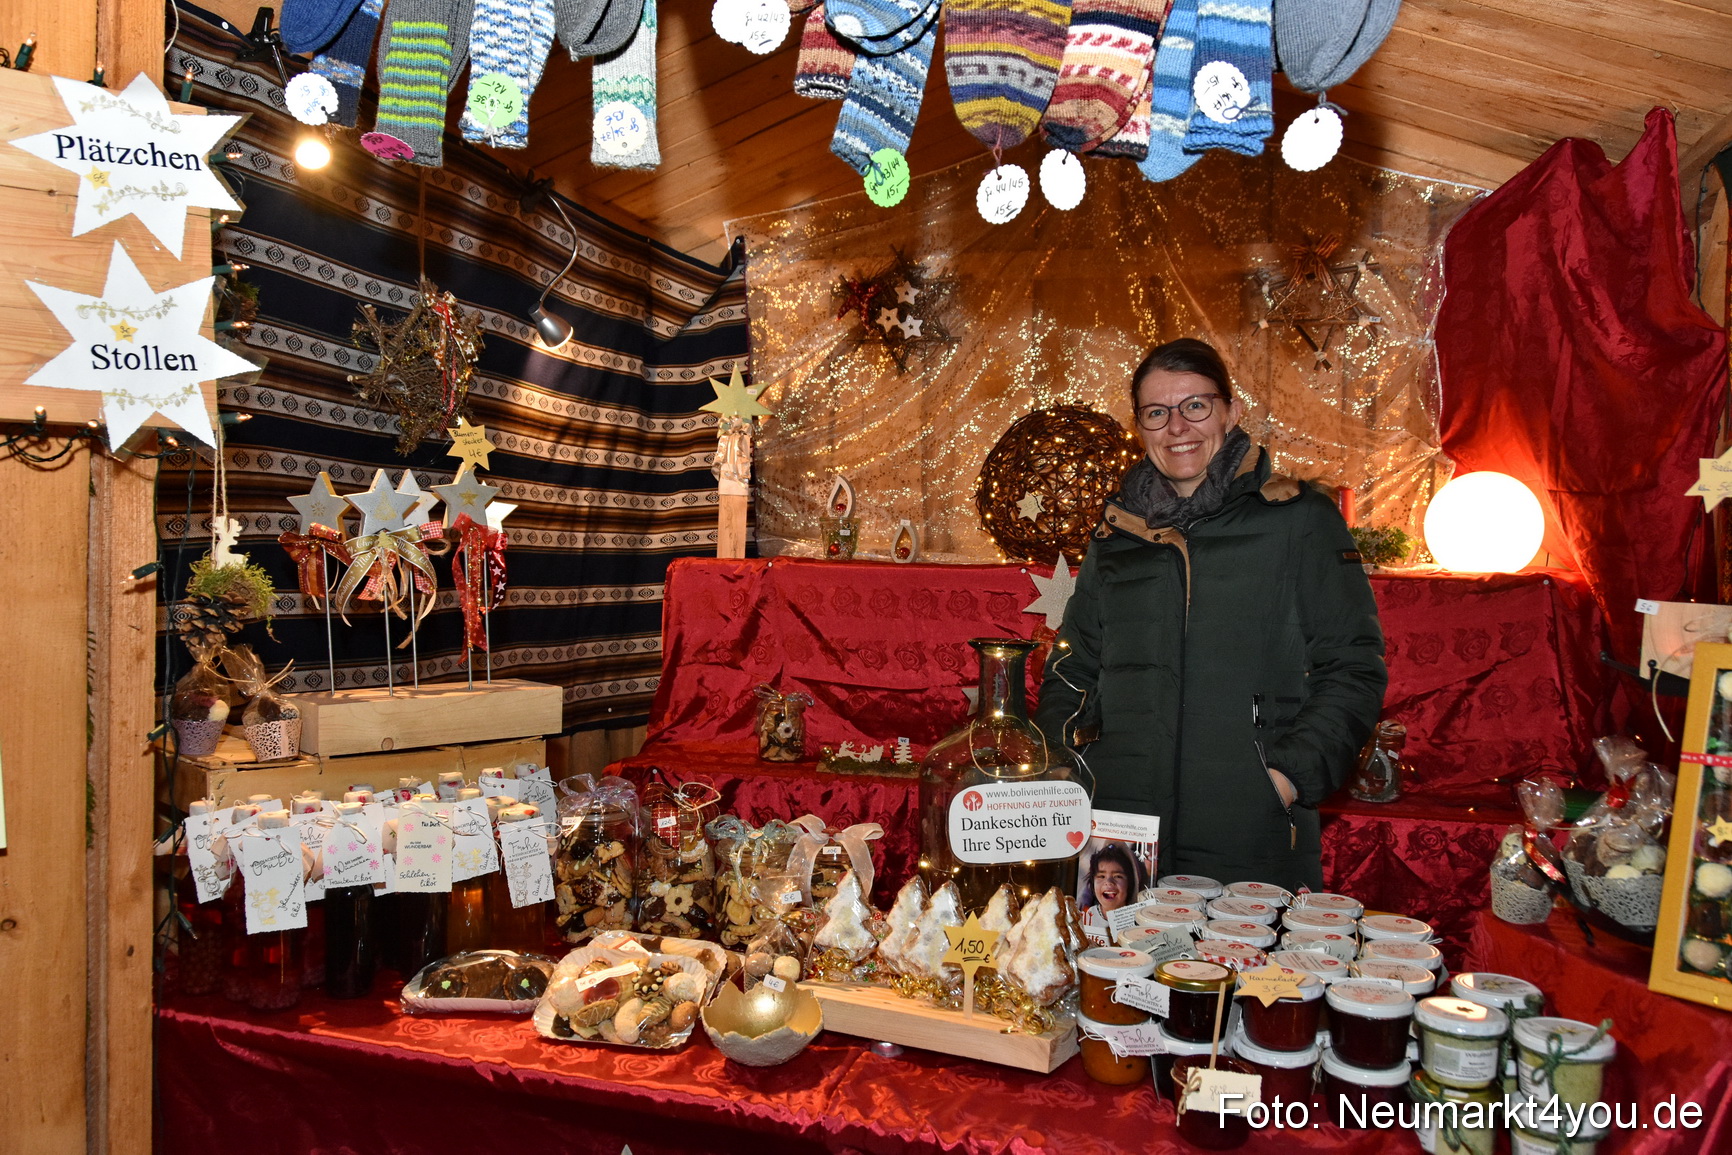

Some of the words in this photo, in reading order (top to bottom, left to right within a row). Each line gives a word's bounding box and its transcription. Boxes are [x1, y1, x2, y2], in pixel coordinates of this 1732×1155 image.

[52, 133, 202, 171] Plätzchen
[90, 343, 199, 372] Stollen
[985, 786, 1083, 798] www.bolivienhilfe.com
[986, 801, 1031, 811] HOFFNUNG
[1032, 800, 1047, 809] AUF
[1049, 798, 1083, 808] ZUKUNFT
[961, 814, 1048, 832] Dankeschön
[1052, 812, 1072, 827] für
[962, 837, 992, 853] Ihre
[995, 834, 1047, 854] Spende
[954, 937, 985, 955] 1,50
[983, 953, 991, 963] €
